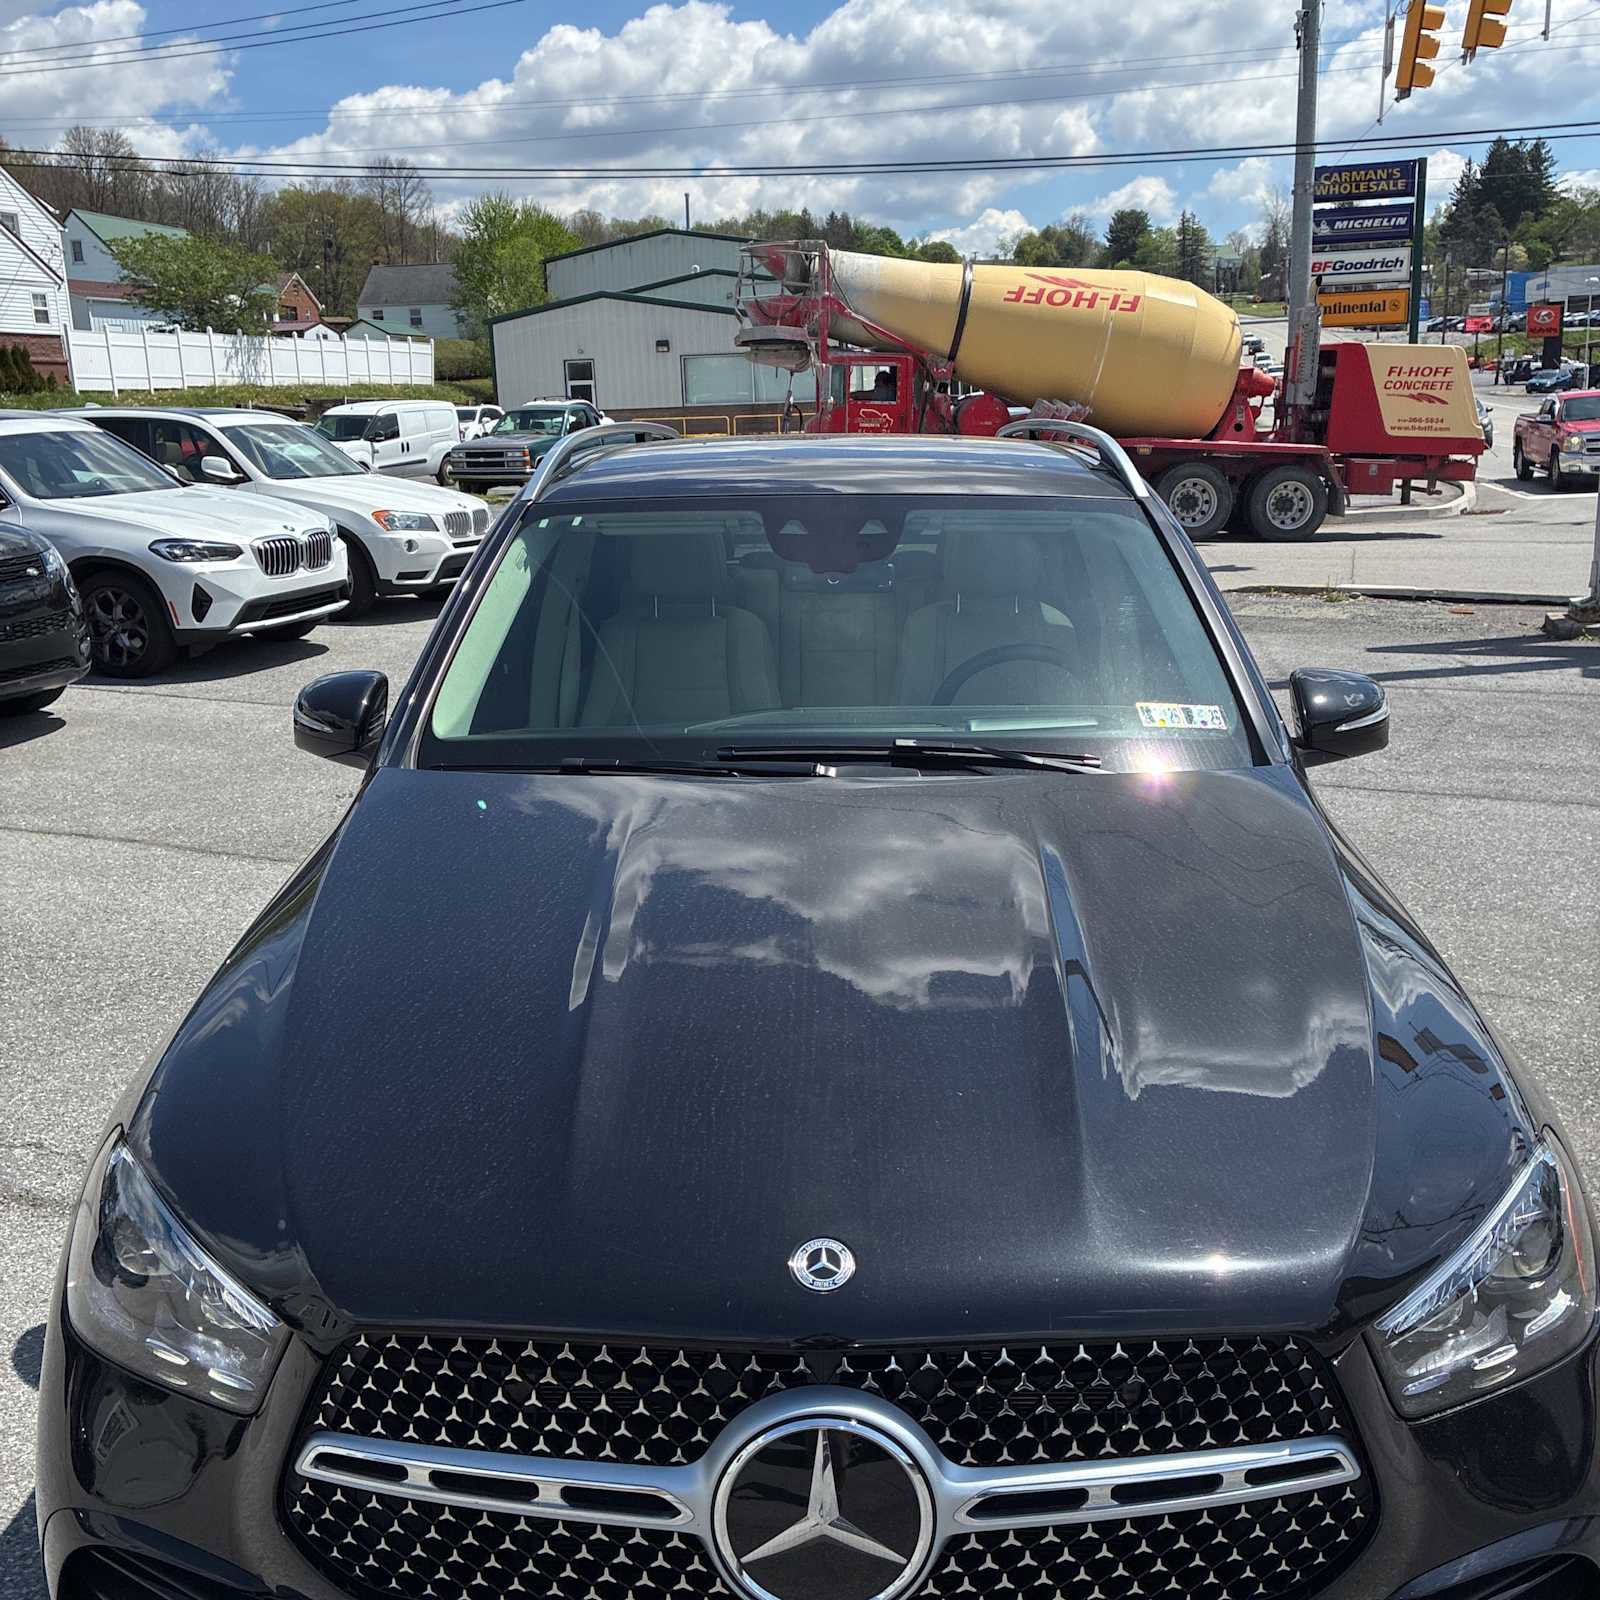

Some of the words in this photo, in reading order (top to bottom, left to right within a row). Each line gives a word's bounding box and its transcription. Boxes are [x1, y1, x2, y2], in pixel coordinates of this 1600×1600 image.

[1320, 167, 1401, 185] CARMAN'S
[1313, 179, 1407, 196] WHOLESALE
[1334, 216, 1408, 230] MICHELIN
[1311, 256, 1404, 273] BFGoodrich
[1003, 286, 1141, 312] FI-HOFF
[1321, 299, 1387, 315] ntinental
[1387, 366, 1454, 378] FI-HOFF
[1383, 380, 1454, 391] CONCRETE
